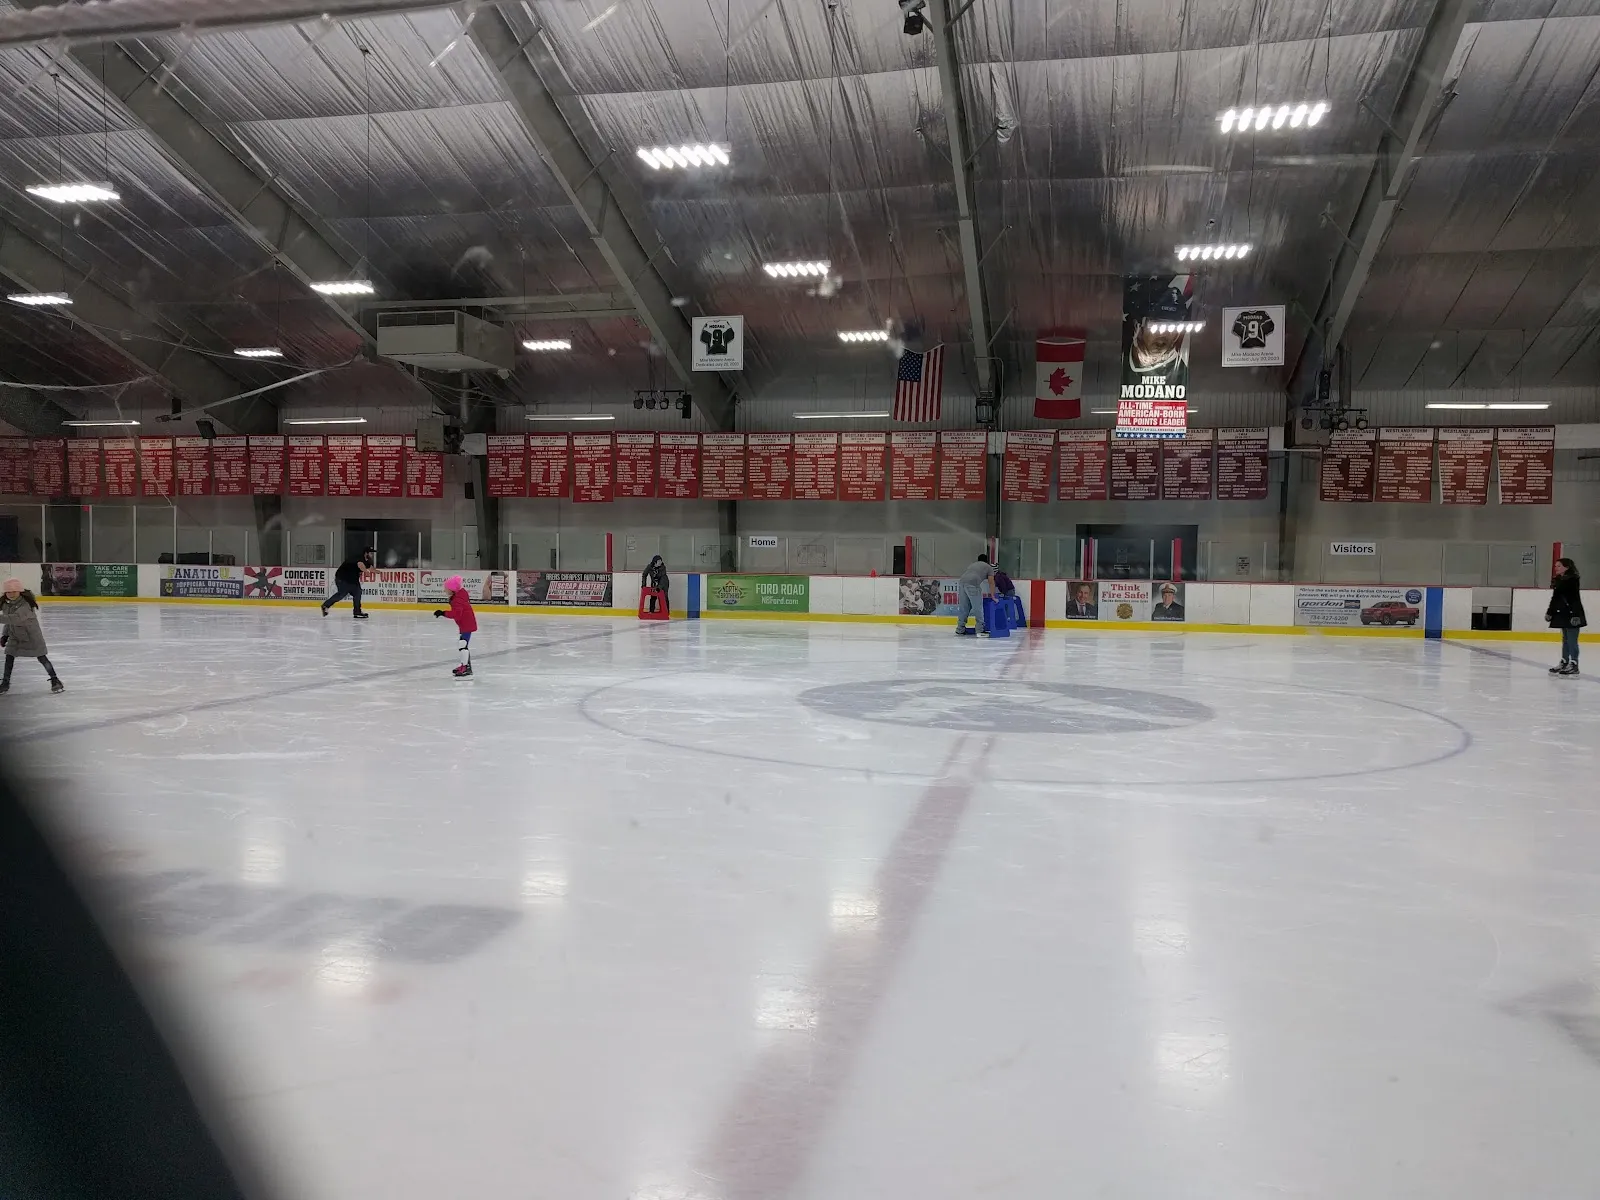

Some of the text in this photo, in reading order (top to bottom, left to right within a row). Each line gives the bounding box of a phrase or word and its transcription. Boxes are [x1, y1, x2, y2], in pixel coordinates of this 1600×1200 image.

[1248, 320, 1259, 339] 9
[712, 329, 723, 345] 9
[1142, 376, 1166, 384] MIKE
[1120, 384, 1186, 399] MODANO
[1333, 544, 1374, 553] Visitors
[285, 571, 325, 579] CONCRETE
[380, 572, 414, 583] WINGS
[756, 584, 805, 595] FORD ROAD
